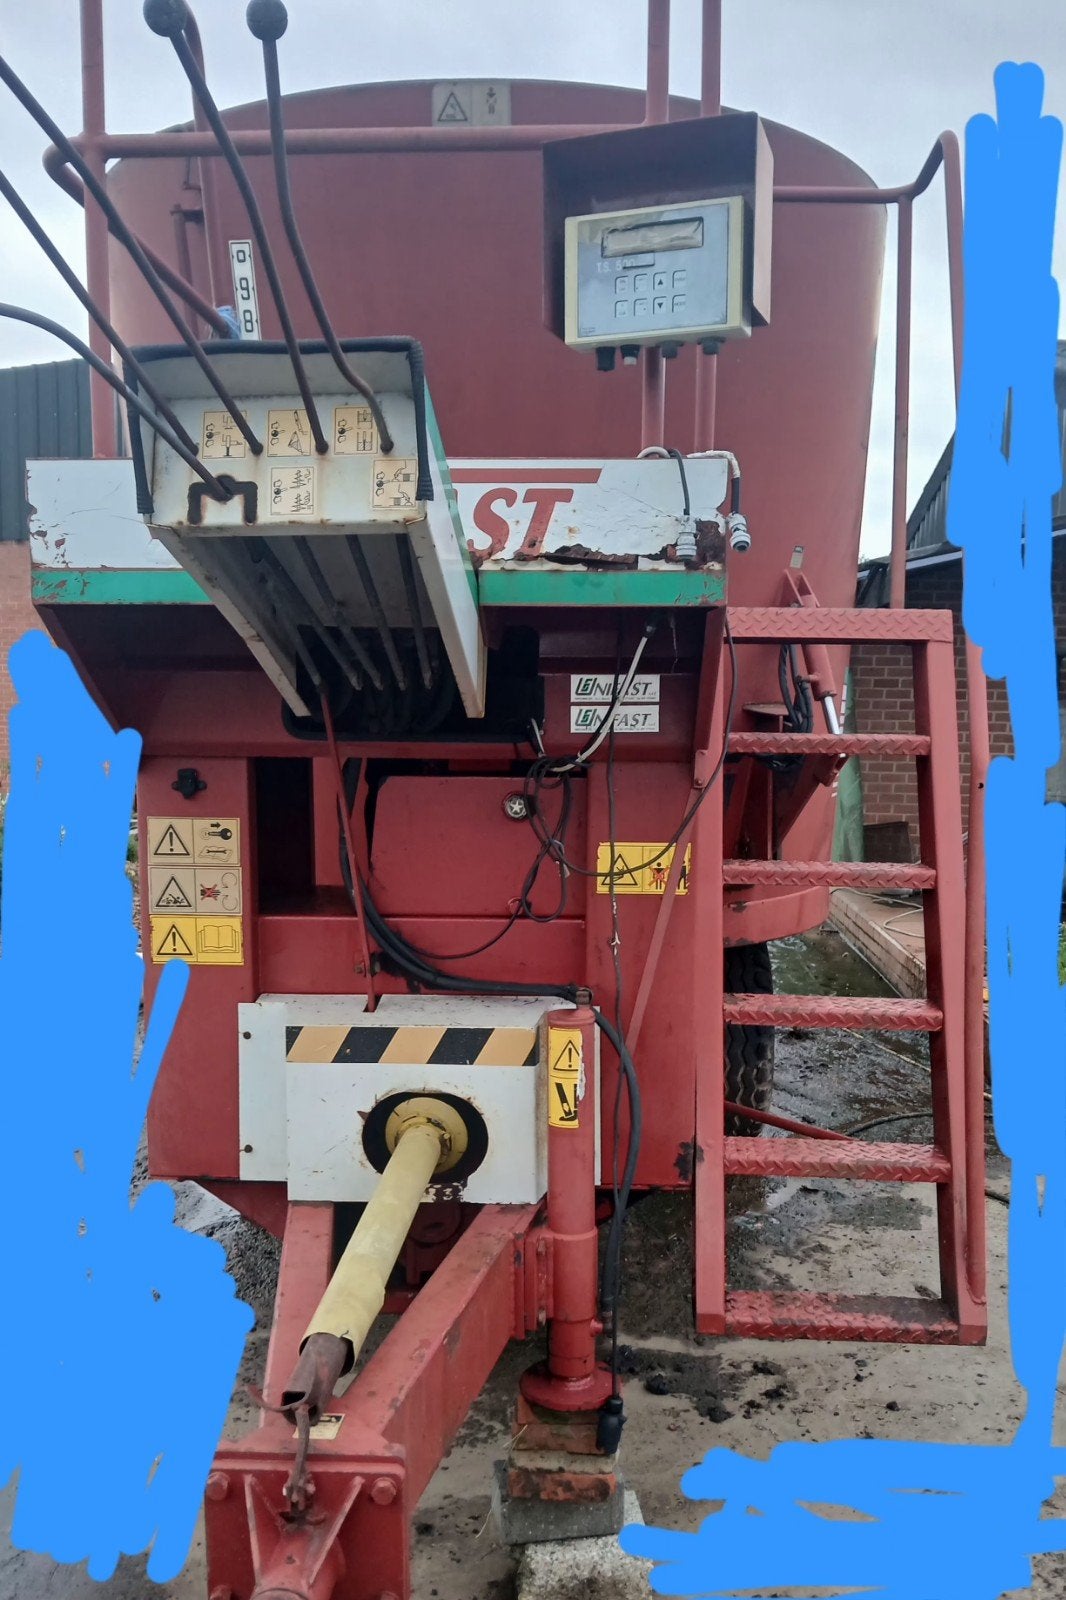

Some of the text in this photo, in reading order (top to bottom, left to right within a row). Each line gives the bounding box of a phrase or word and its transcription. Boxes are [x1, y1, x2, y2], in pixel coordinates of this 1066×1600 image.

[239, 277, 250, 301] 9
[243, 309, 254, 333] 8
[453, 487, 574, 562] ST
[575, 677, 652, 696] UNIST
[575, 708, 652, 727] UNFAST
